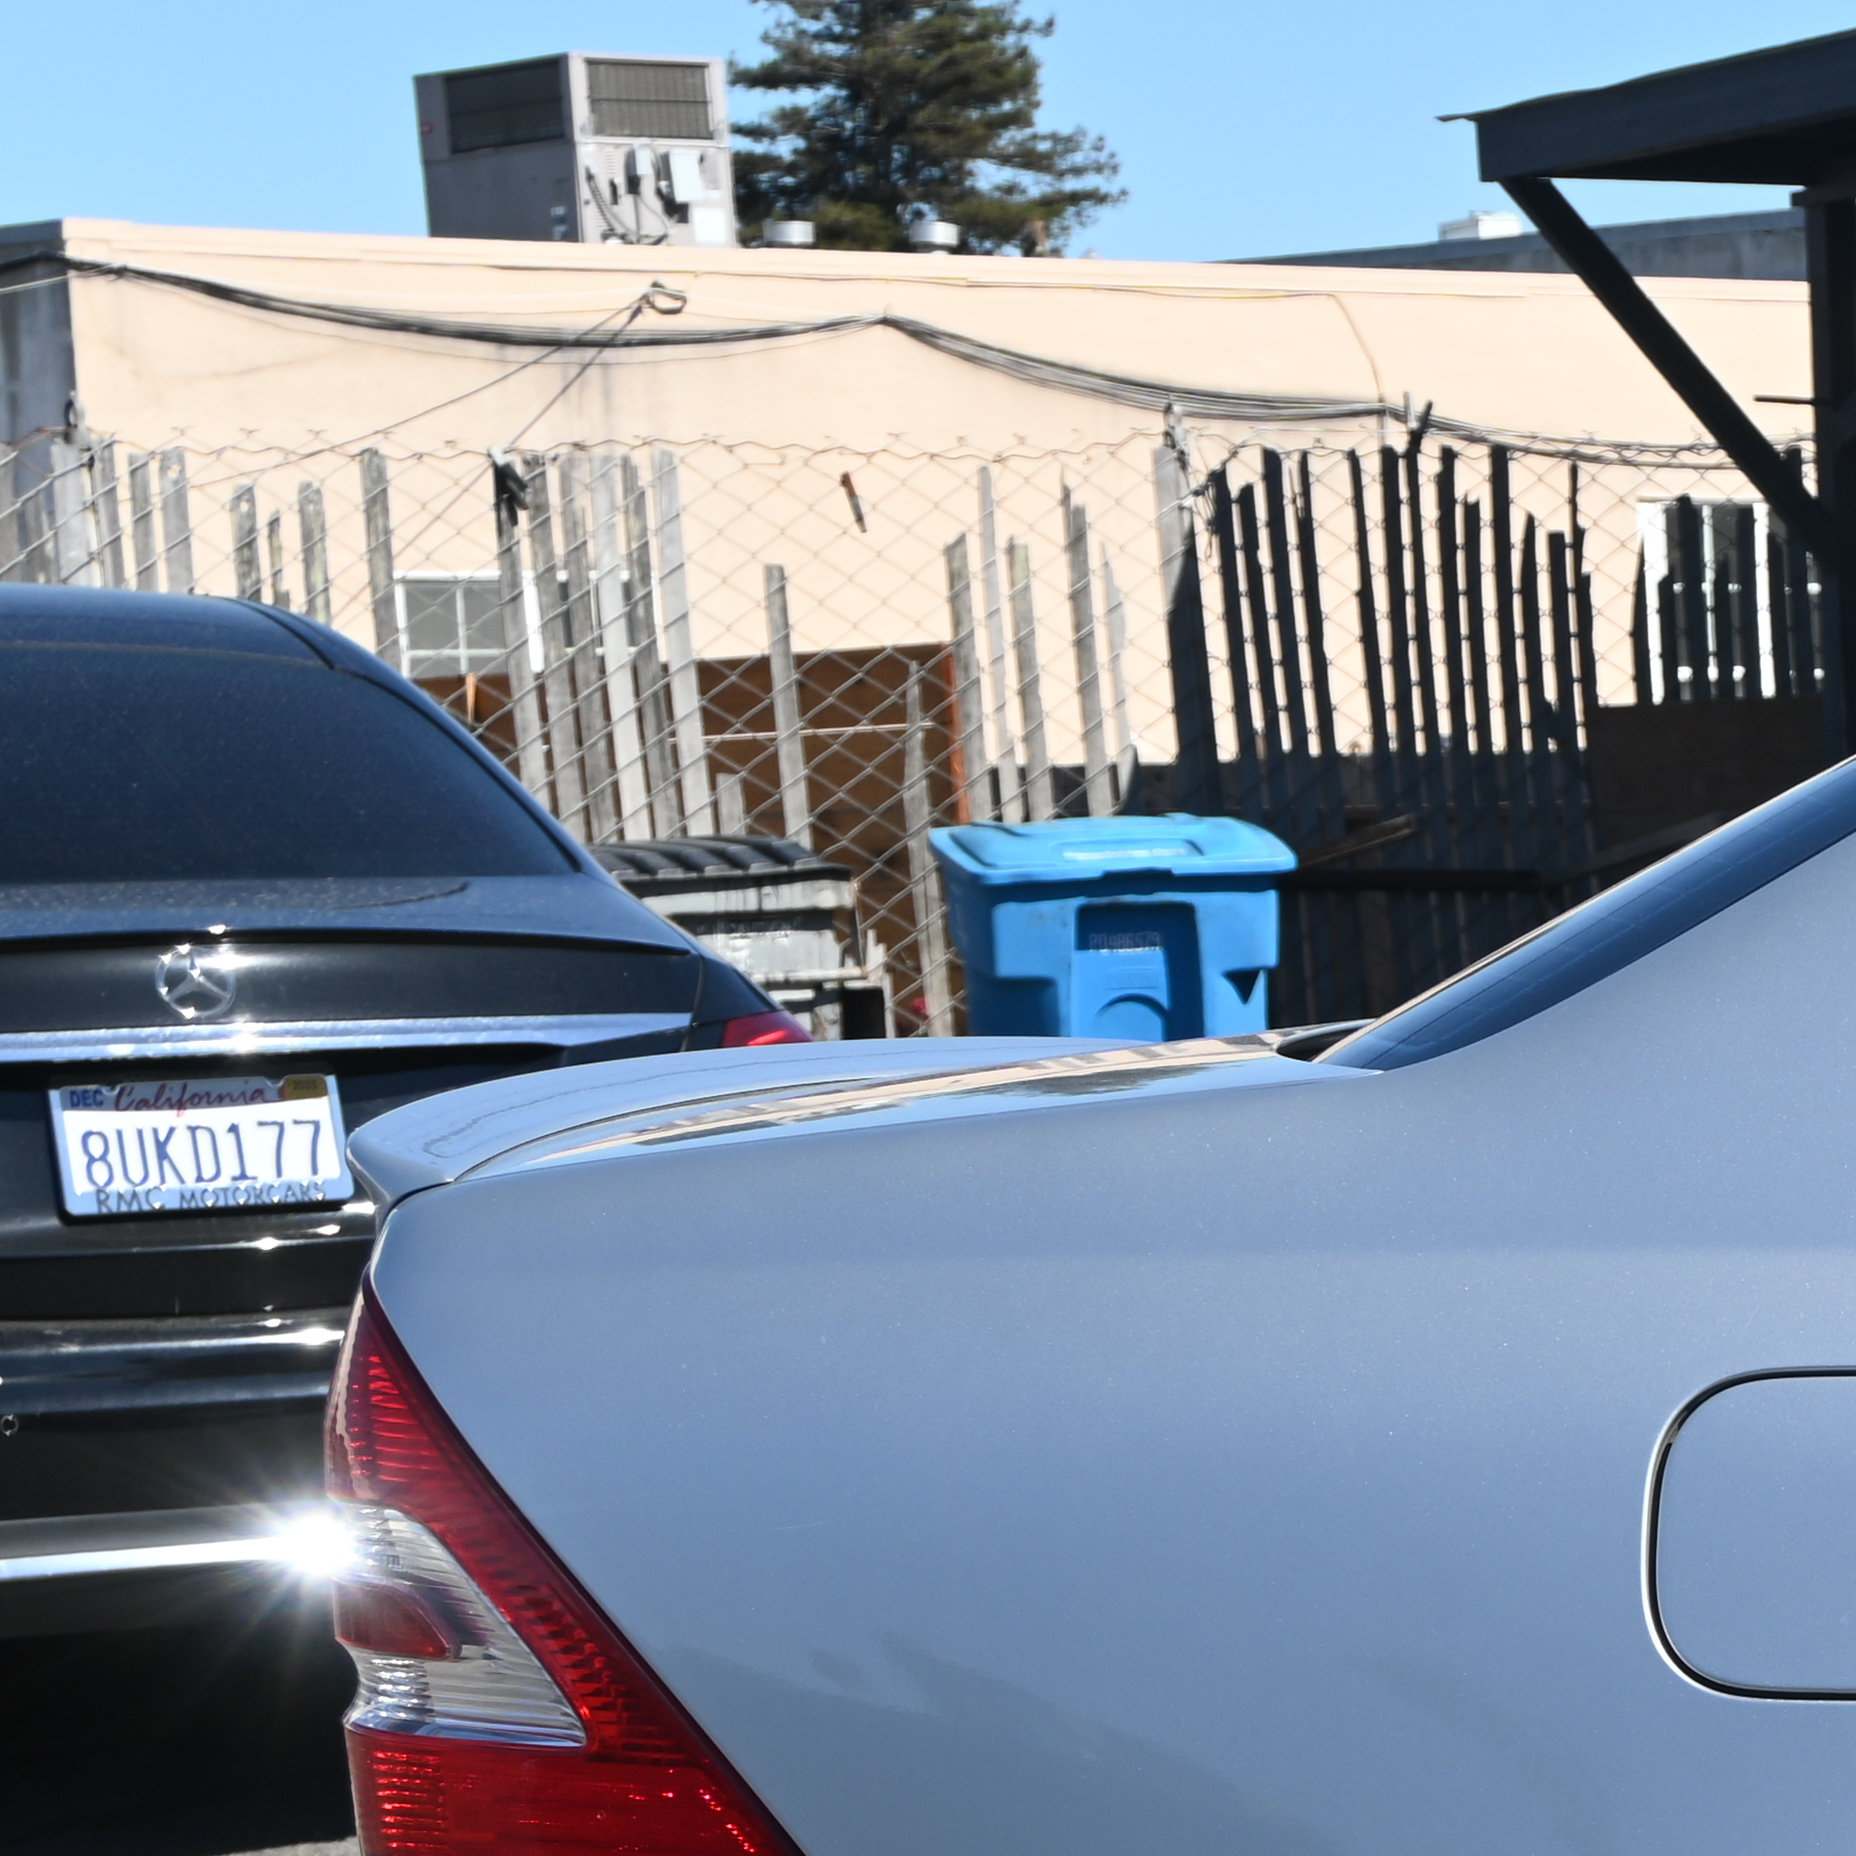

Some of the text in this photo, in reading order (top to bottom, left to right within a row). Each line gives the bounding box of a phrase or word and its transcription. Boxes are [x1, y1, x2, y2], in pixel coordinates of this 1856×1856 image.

[70, 1089, 104, 1108] DEC
[113, 1080, 266, 1117] California
[81, 1119, 321, 1188] 8UKD177
[96, 1182, 326, 1215] RMC MOTORCARS
